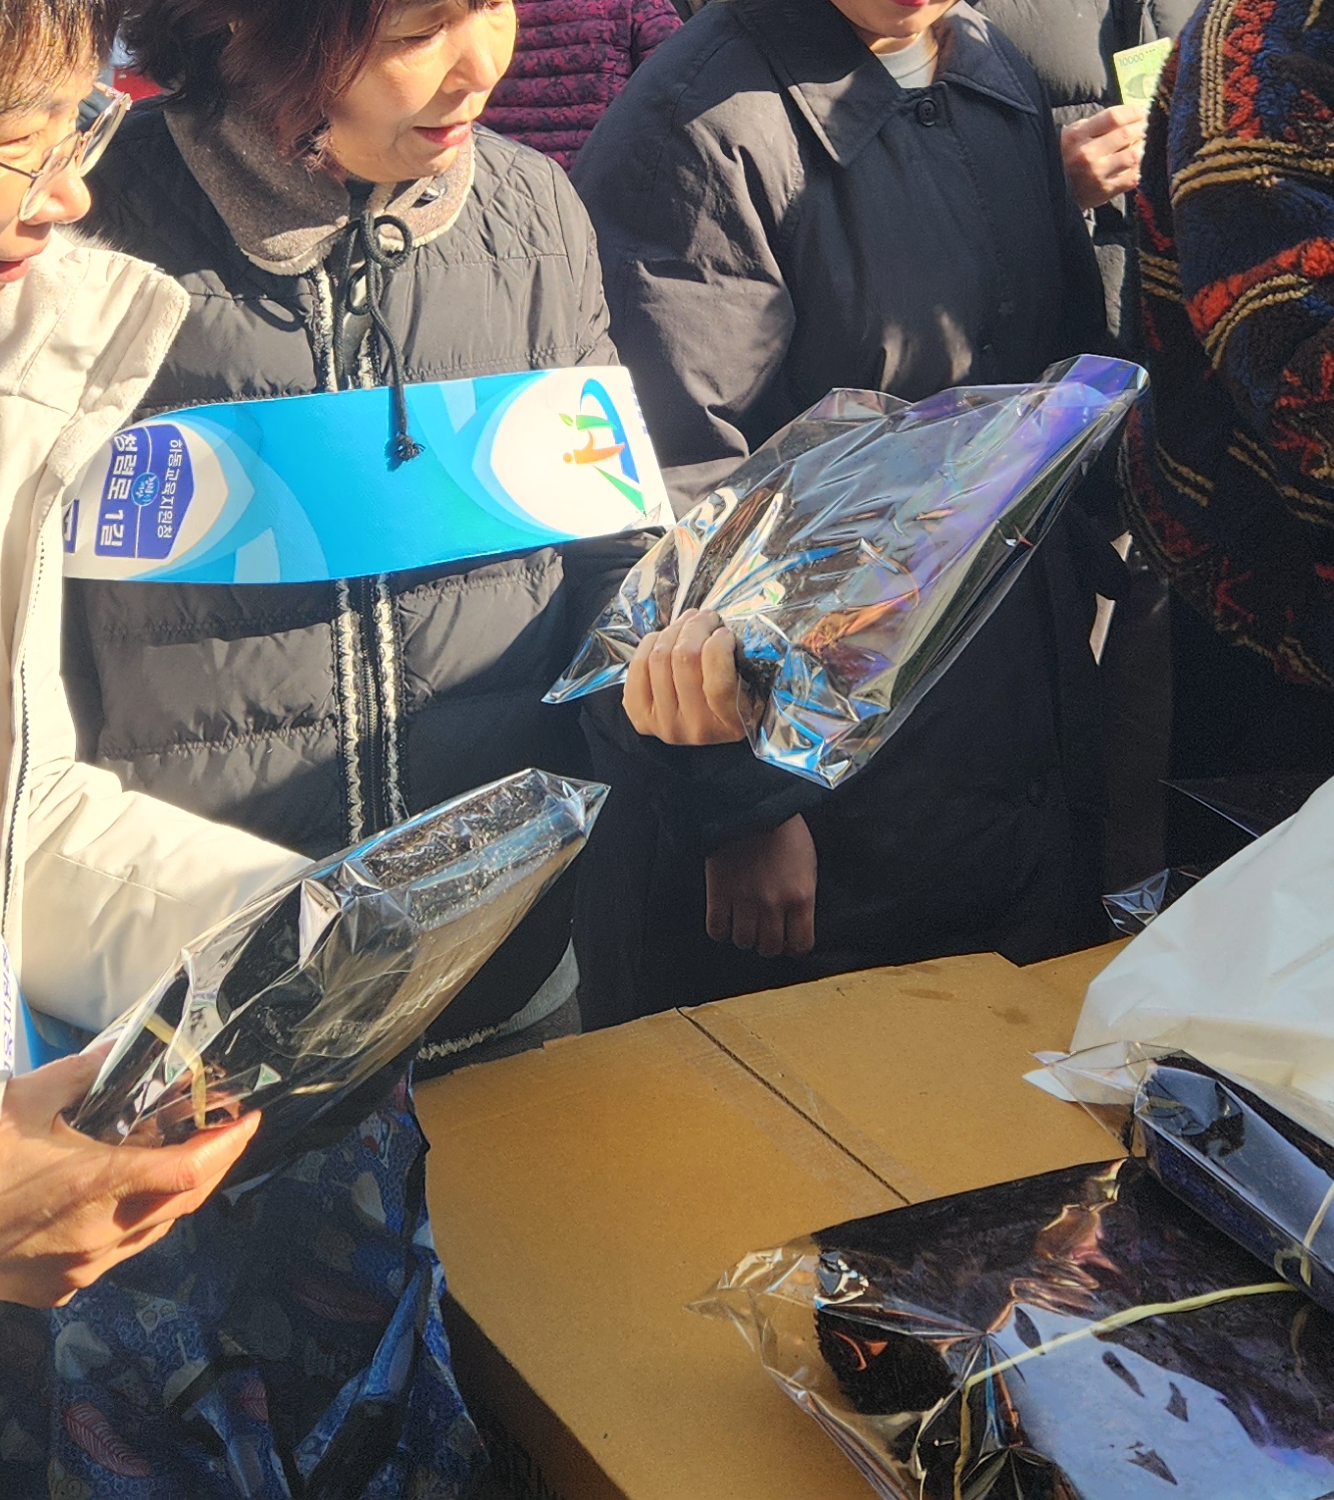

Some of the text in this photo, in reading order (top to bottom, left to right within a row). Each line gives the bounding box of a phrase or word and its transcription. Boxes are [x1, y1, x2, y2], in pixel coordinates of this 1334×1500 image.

[100, 434, 139, 547] 청렴로 1길
[157, 439, 183, 538] 하동교육지원청
